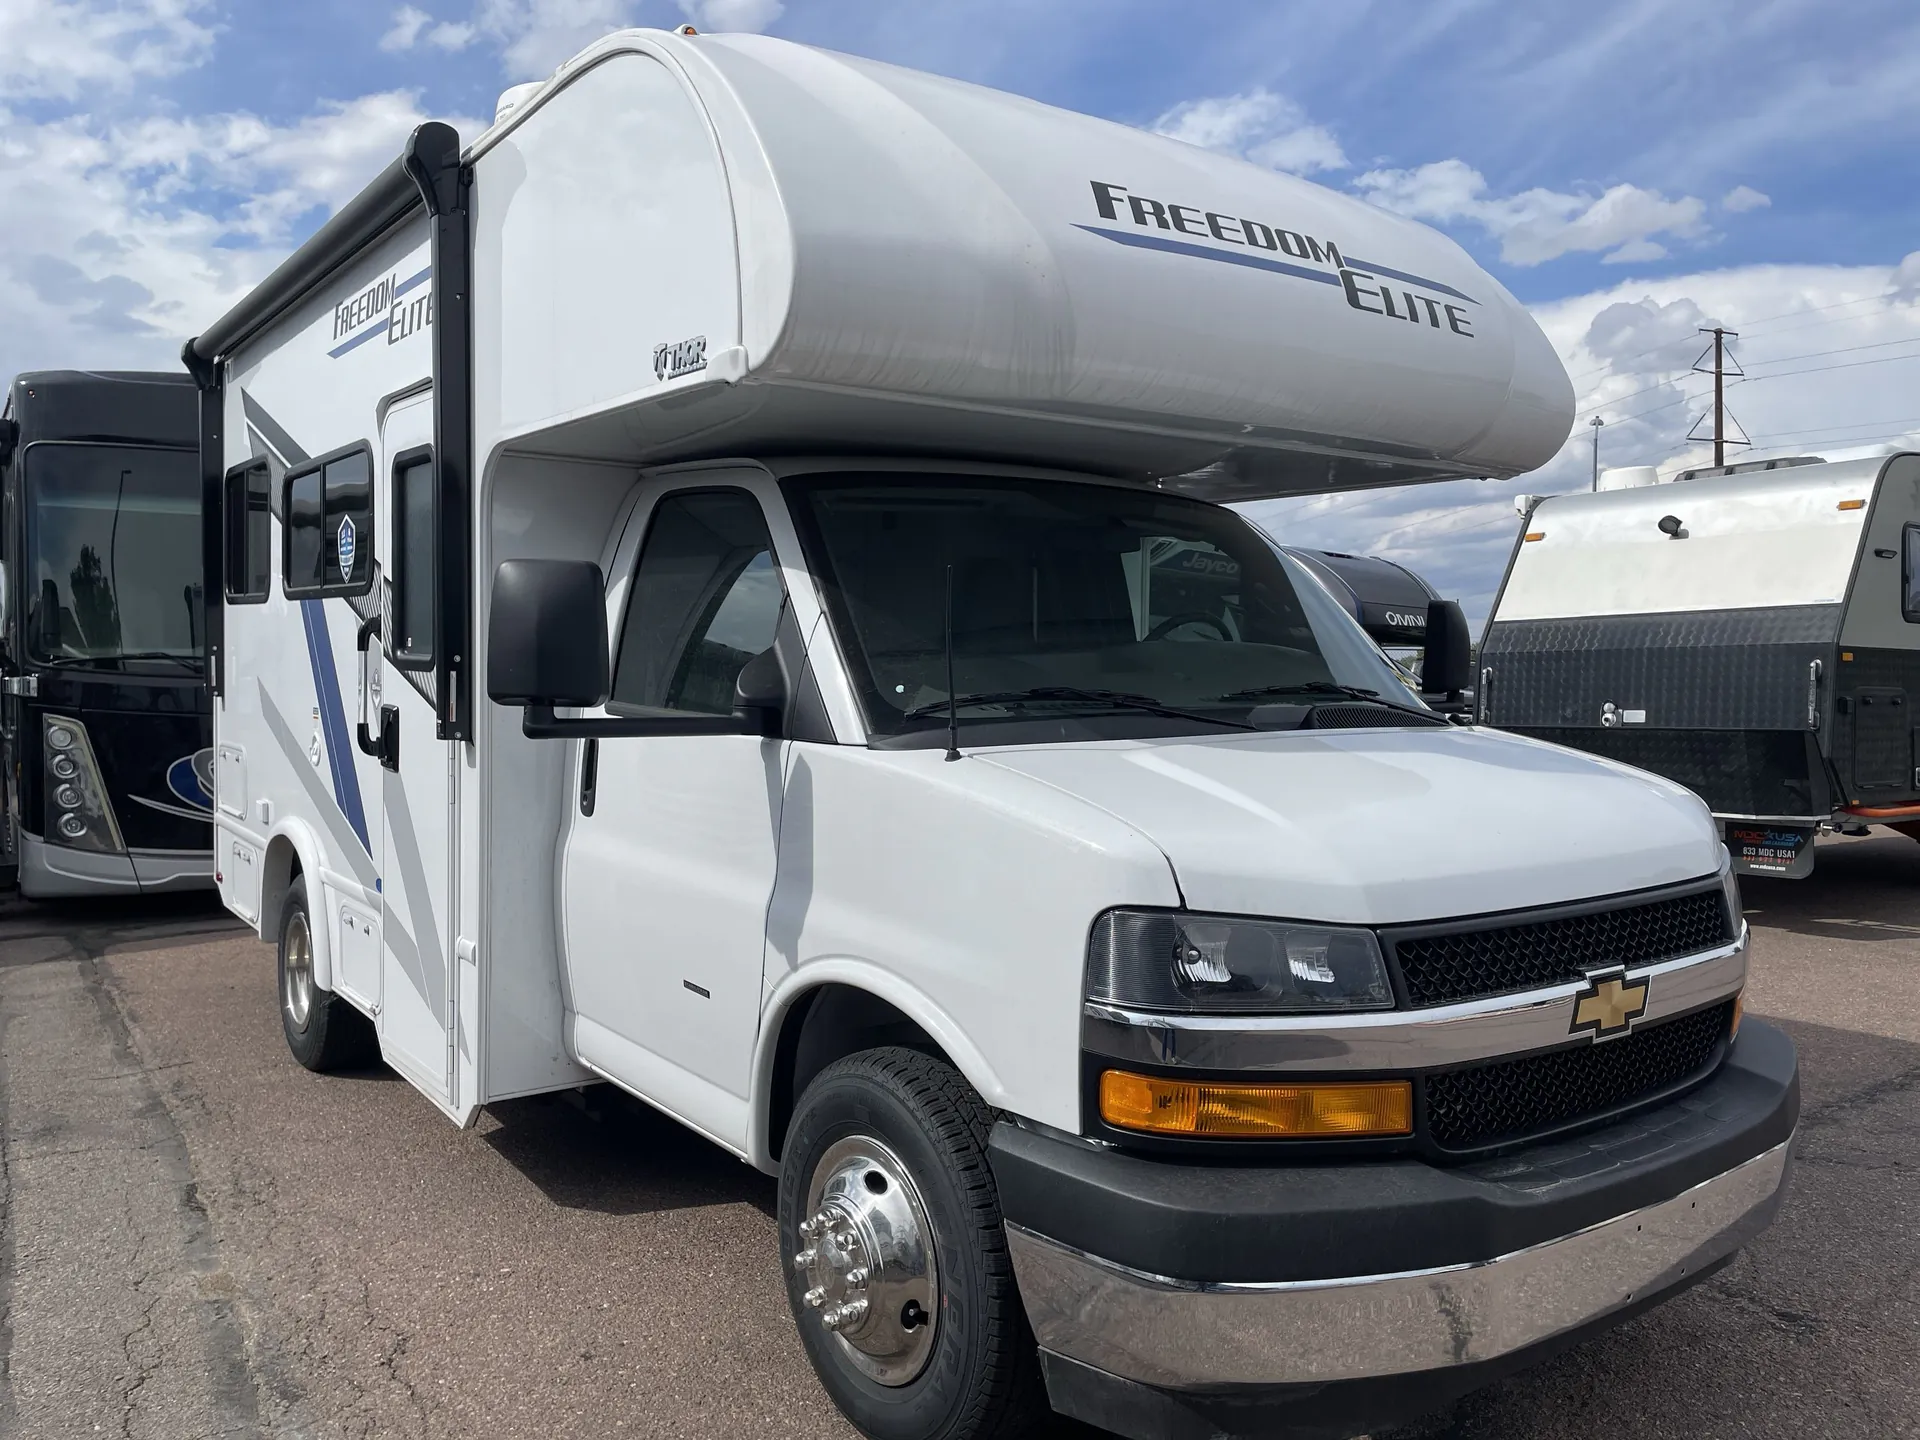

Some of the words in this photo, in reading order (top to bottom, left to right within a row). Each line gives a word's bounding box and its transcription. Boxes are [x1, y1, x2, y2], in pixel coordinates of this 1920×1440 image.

[1089, 180, 1345, 269] FREEDOM
[333, 272, 396, 341] FREEDOM
[1339, 268, 1475, 338] ELITE
[667, 335, 707, 371] THOR
[1182, 552, 1239, 574] Jayco
[1385, 610, 1426, 627] OMNI
[1743, 846, 1756, 855] 833
[1758, 847, 1775, 857] MDC
[1776, 849, 1796, 859] USA1
